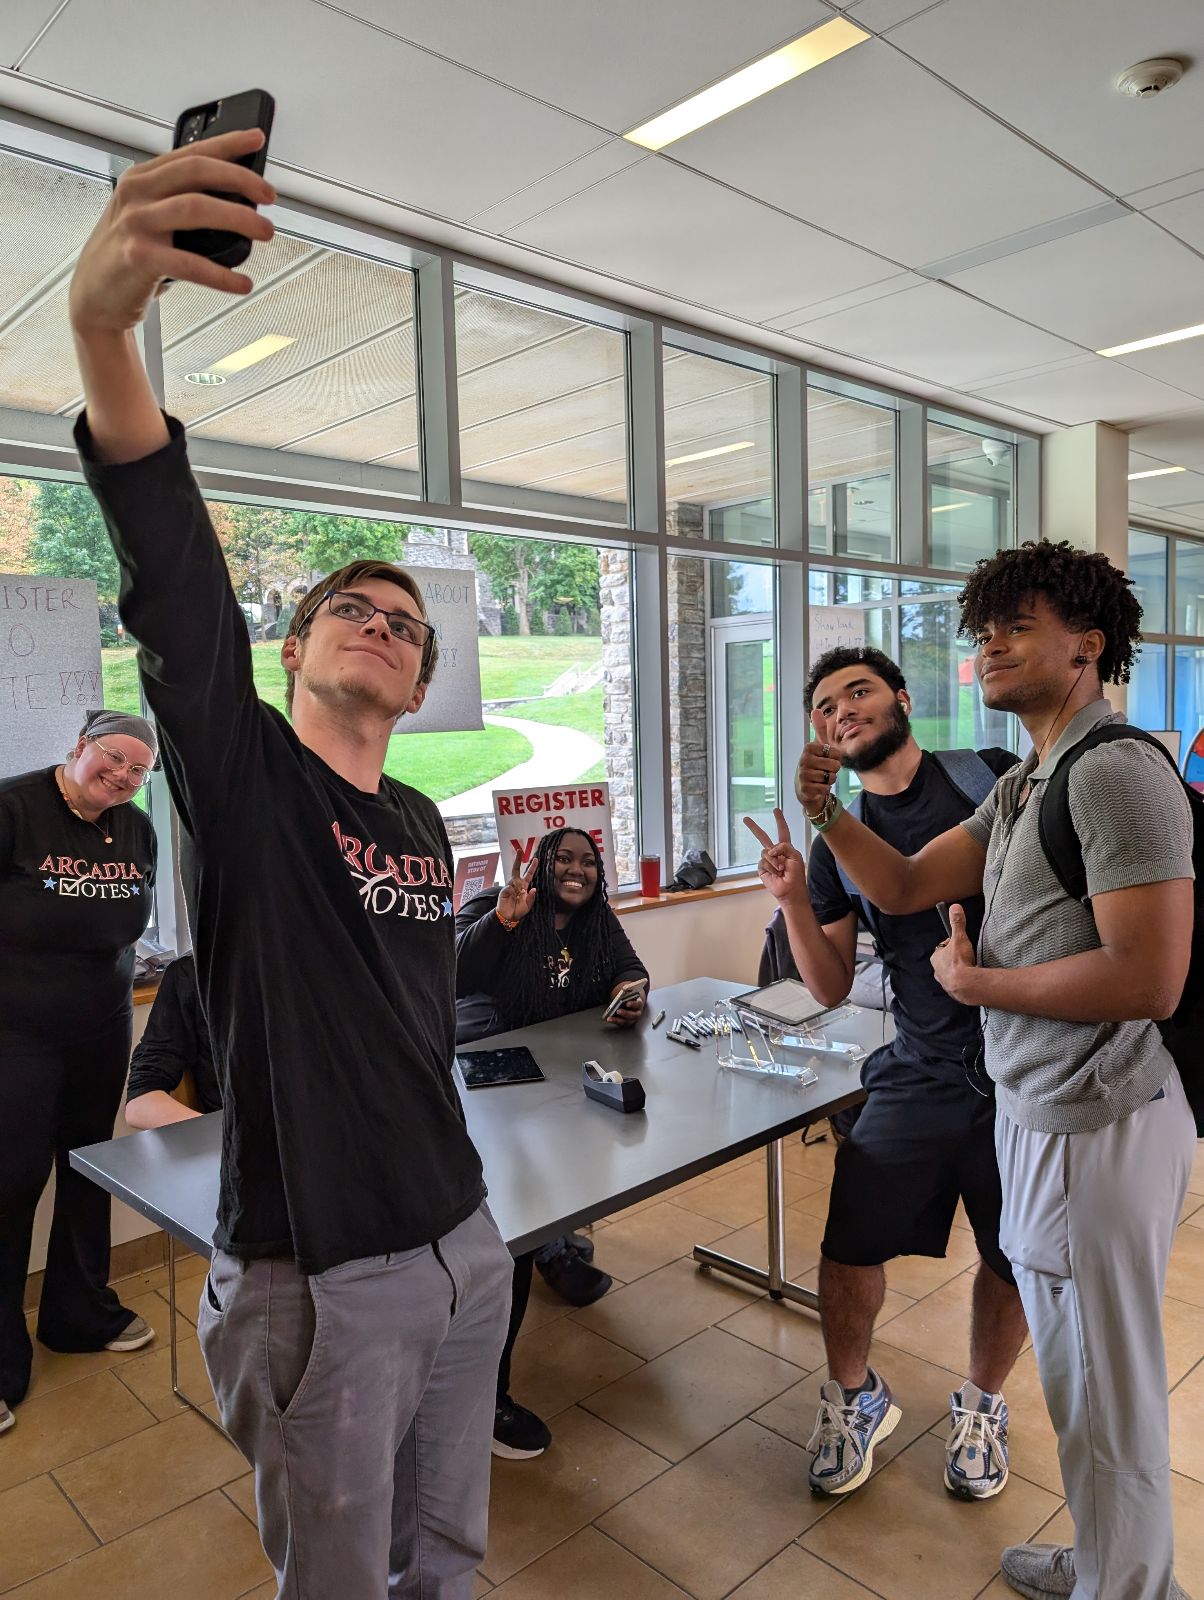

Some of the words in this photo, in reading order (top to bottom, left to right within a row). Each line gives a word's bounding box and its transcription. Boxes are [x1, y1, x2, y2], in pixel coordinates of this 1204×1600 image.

[422, 583, 470, 604] ABOUT
[497, 789, 605, 816] REGISTER
[543, 816, 566, 830] TO
[510, 829, 605, 864] VE
[38, 854, 144, 881] ARCADIA
